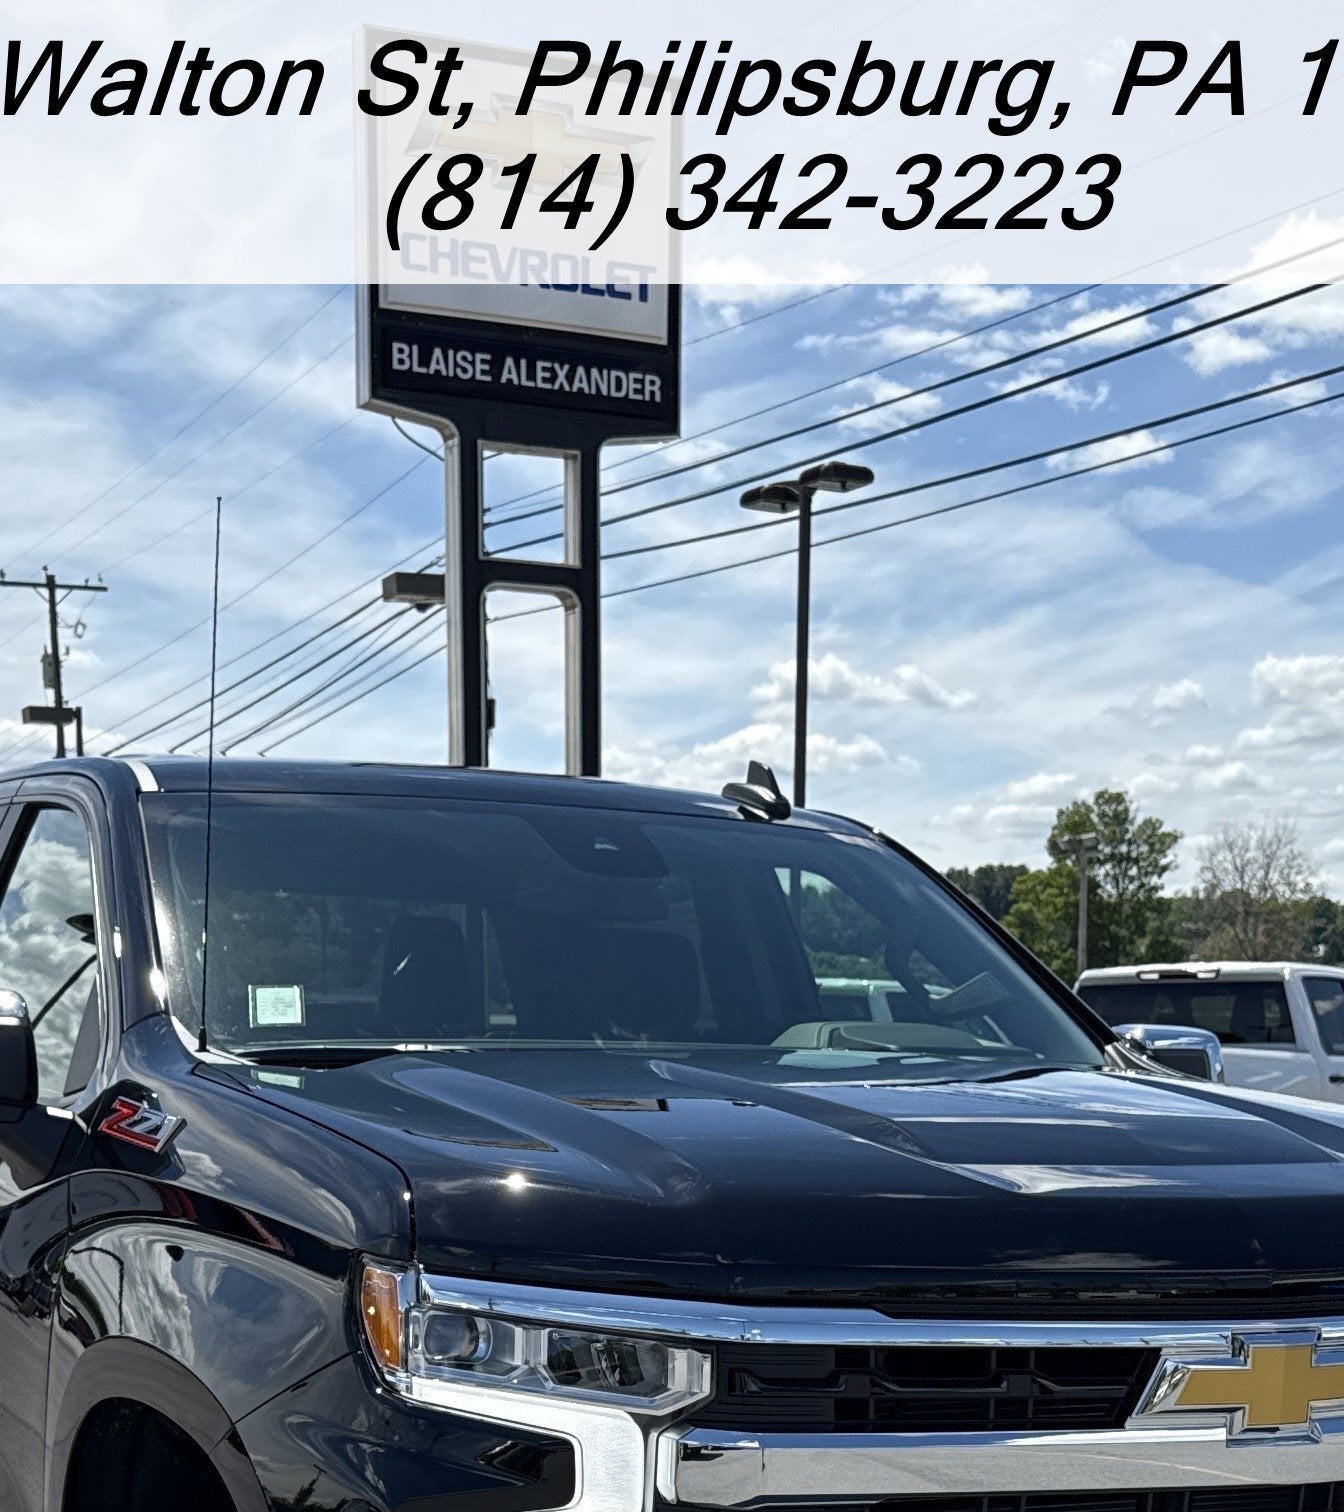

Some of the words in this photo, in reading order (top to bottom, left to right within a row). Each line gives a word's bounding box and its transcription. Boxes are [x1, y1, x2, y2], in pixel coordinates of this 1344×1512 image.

[399, 231, 657, 303] CHEVROLET
[391, 341, 492, 383] BLAISE
[500, 356, 662, 403] ALEXANDER
[98, 1095, 188, 1155] Z71
